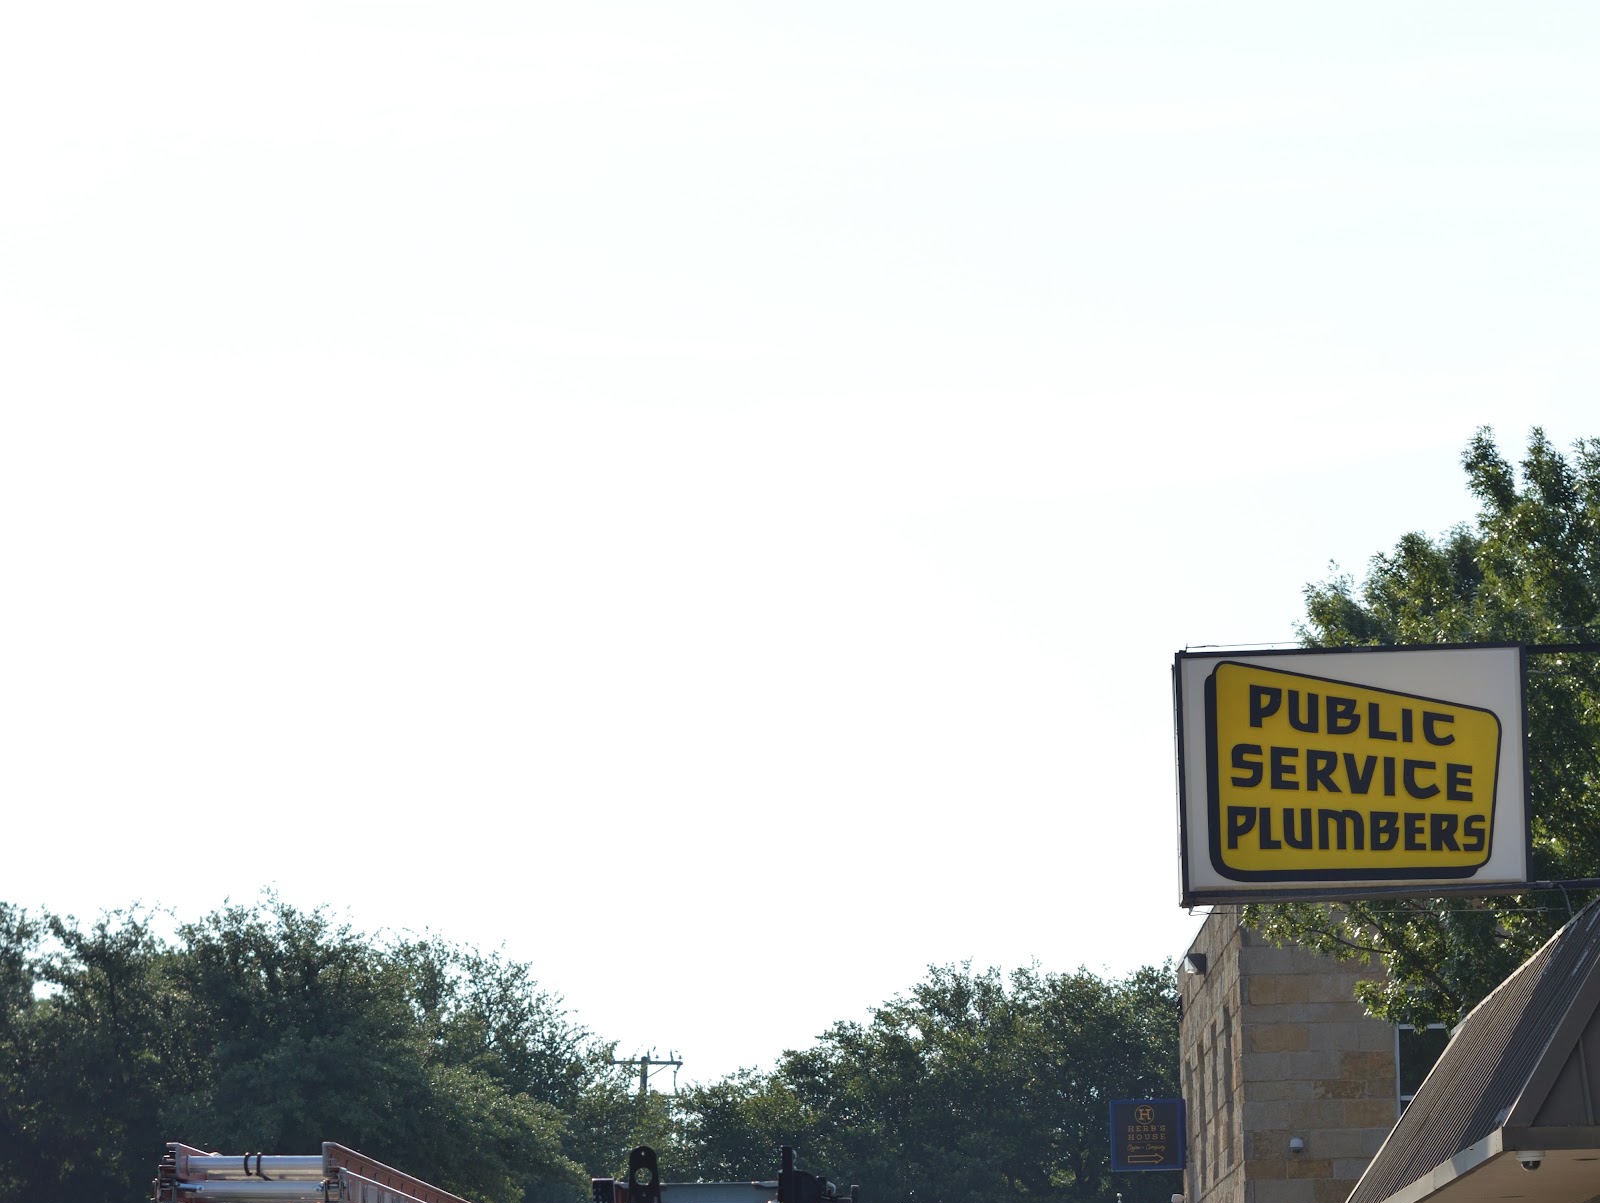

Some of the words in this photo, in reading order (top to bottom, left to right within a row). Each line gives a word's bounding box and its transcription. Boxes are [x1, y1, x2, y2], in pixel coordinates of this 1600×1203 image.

[1249, 684, 1455, 746] PUBLIC
[1231, 743, 1473, 802] SERVICE
[1227, 805, 1486, 851] PLUMBERS
[1127, 1133, 1166, 1141] HOUSE
